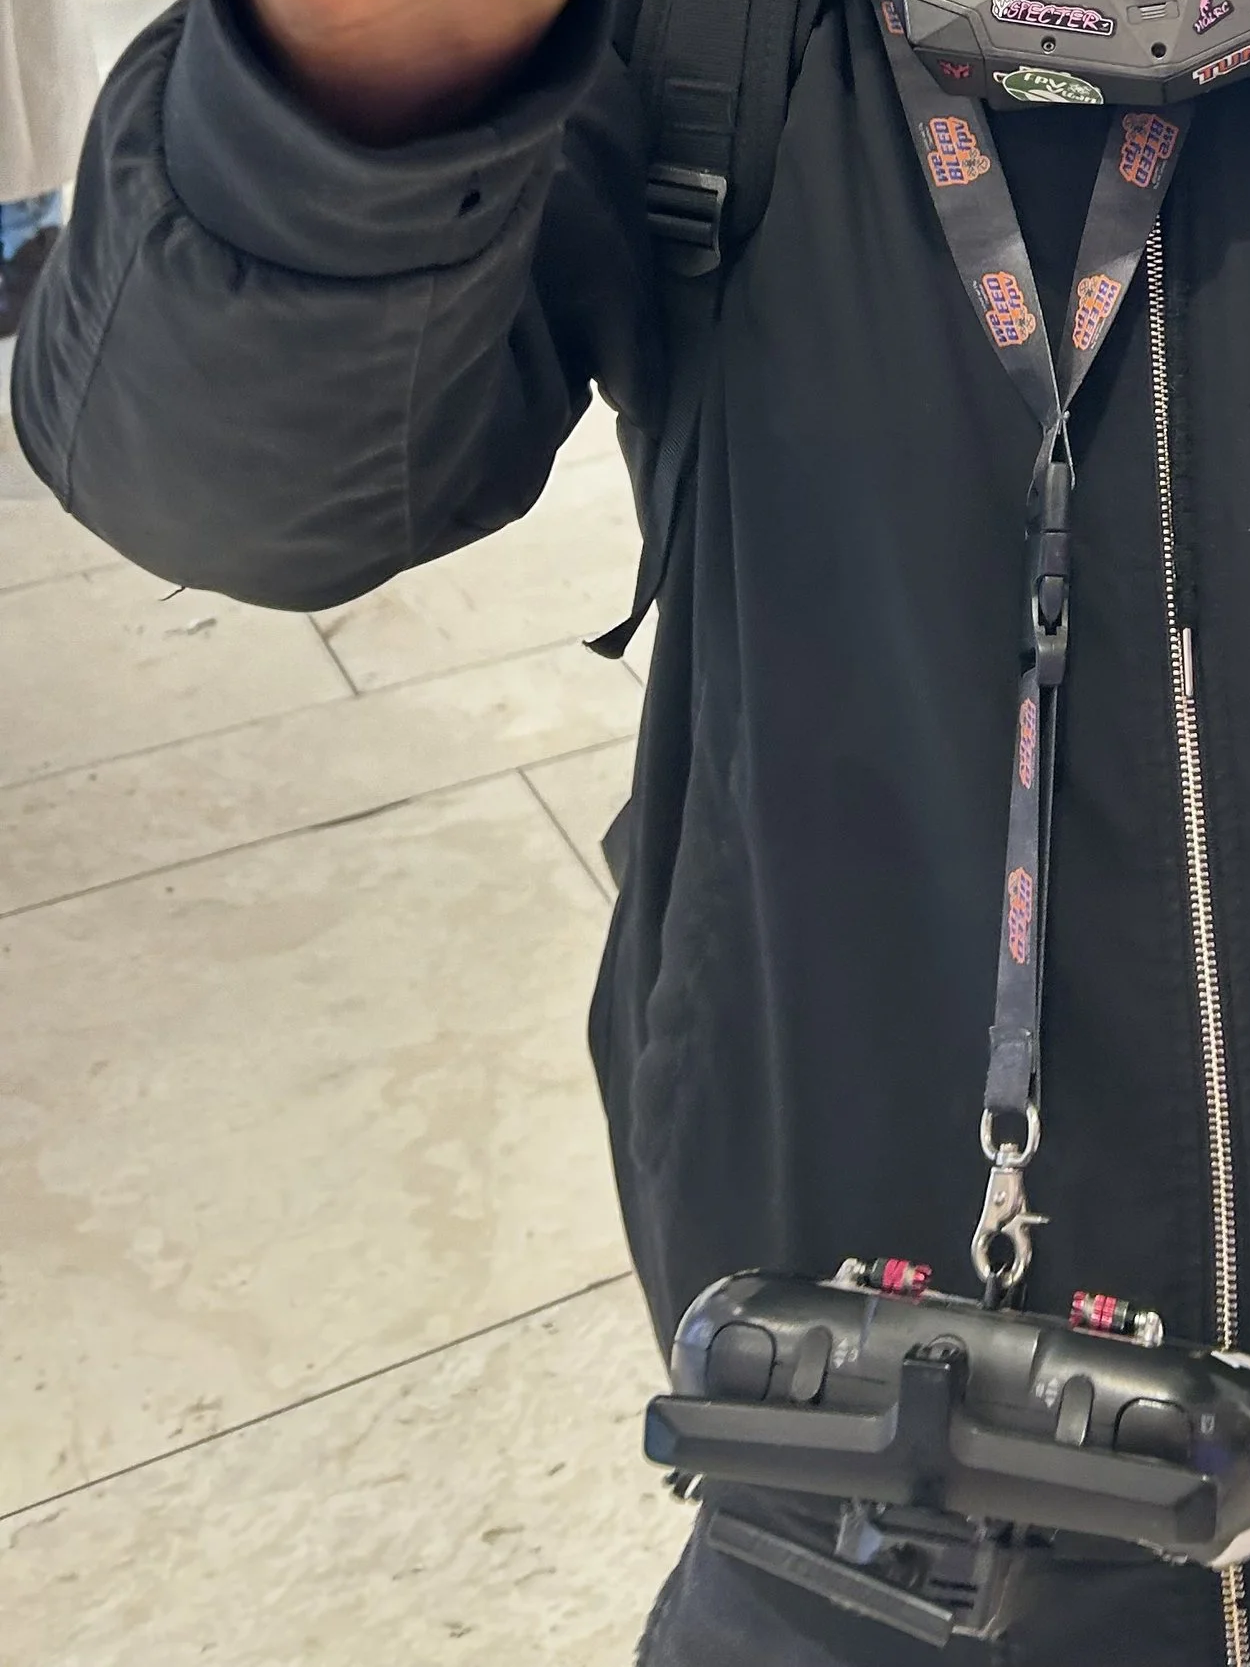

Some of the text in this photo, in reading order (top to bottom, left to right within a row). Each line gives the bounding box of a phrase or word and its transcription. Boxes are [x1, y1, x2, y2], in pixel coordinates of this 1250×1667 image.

[934, 121, 964, 181] BLEED
[952, 120, 973, 151] fpv
[1135, 118, 1164, 184] BLEED
[932, 155, 949, 182] we
[986, 277, 1019, 341] BLEED
[1004, 276, 1021, 309] fpv
[1102, 284, 1118, 314] we
[988, 313, 1007, 343] we
[1081, 280, 1109, 346] BLEED
